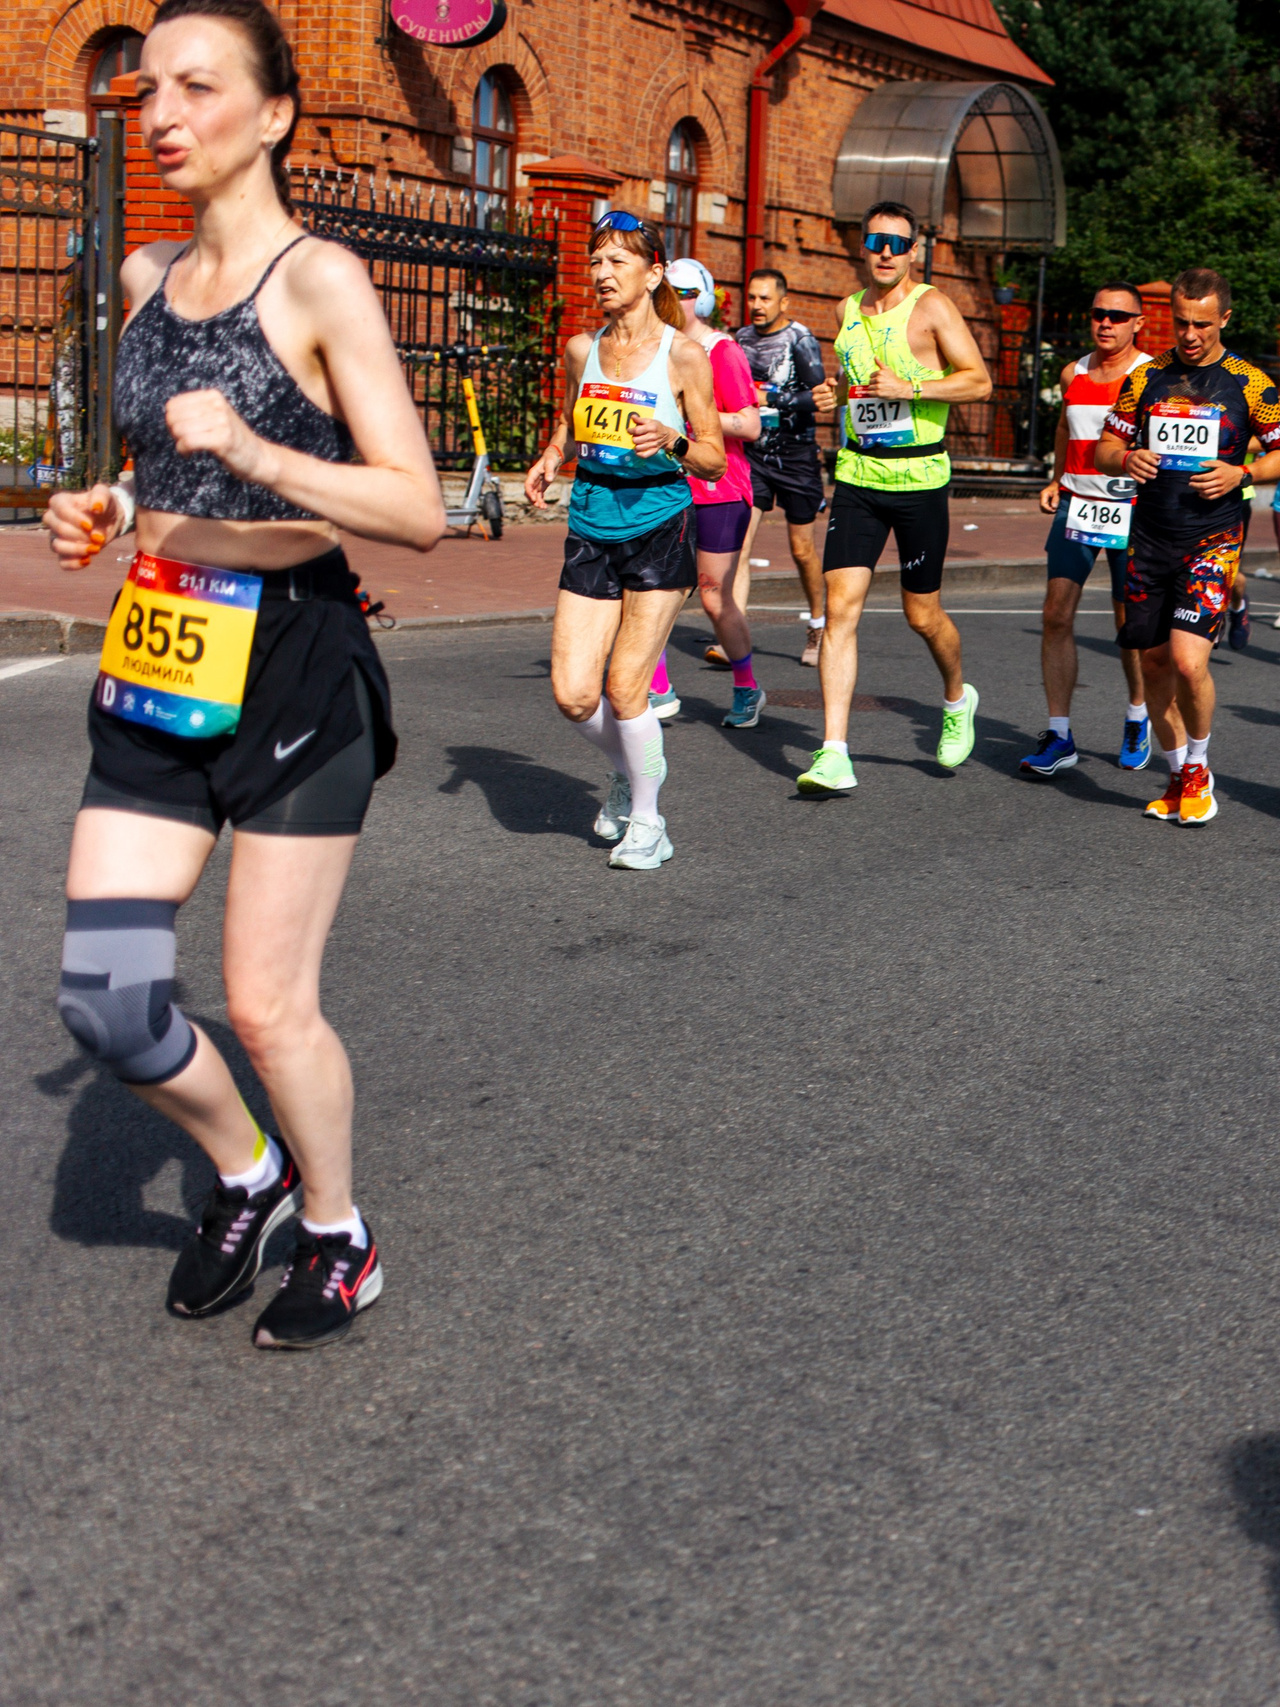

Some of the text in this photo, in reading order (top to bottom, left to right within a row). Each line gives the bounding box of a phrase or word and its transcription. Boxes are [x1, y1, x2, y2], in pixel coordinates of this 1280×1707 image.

[396, 14, 489, 43] СУВЕНИРЫ
[857, 401, 900, 423] 2517
[1107, 413, 1138, 435] ANTO
[1157, 422, 1209, 445] 6120
[592, 431, 622, 442] ЛАРИСА
[1077, 503, 1122, 525] 4186
[1071, 530, 1080, 540] E
[179, 574, 236, 597] 21,1 КМ
[123, 602, 208, 665] 855
[121, 655, 195, 686] ЛЮДМИЛА
[102, 678, 116, 706] D
